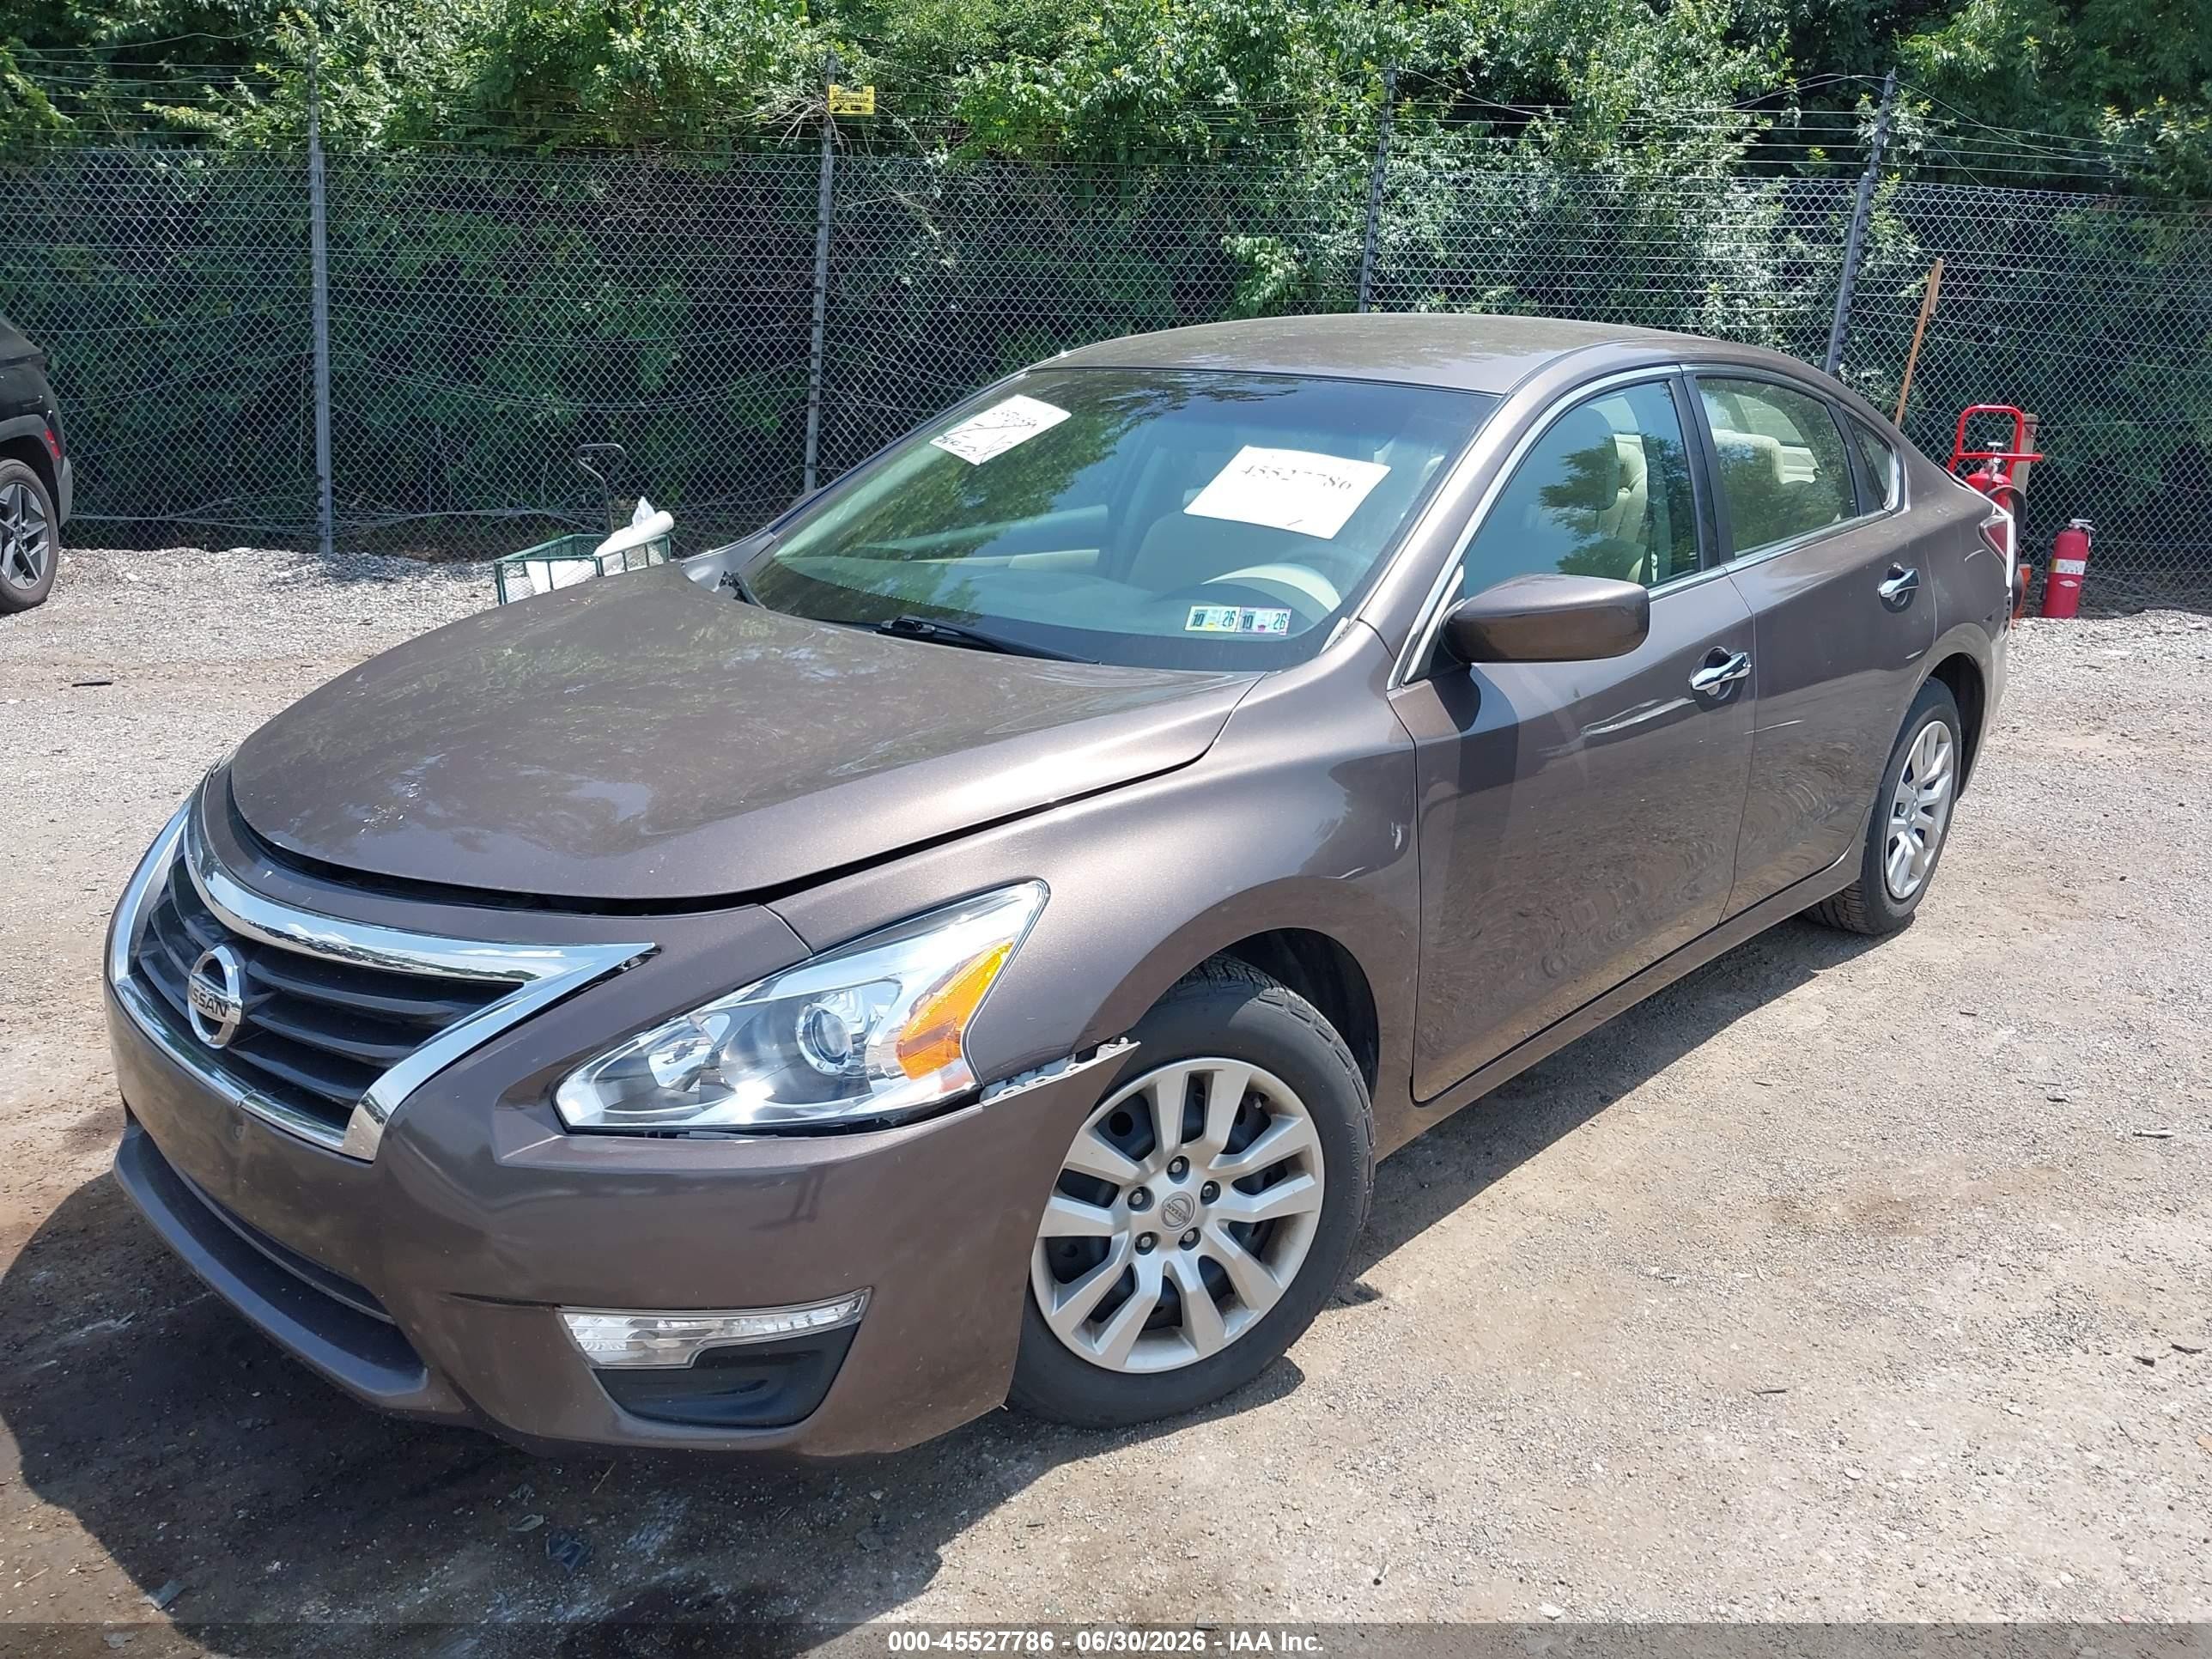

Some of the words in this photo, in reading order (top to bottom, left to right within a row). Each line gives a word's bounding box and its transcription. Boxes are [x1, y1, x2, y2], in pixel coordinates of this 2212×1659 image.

[1193, 612, 1205, 627] 10
[1223, 611, 1237, 627] 26
[1273, 613, 1287, 629] 26
